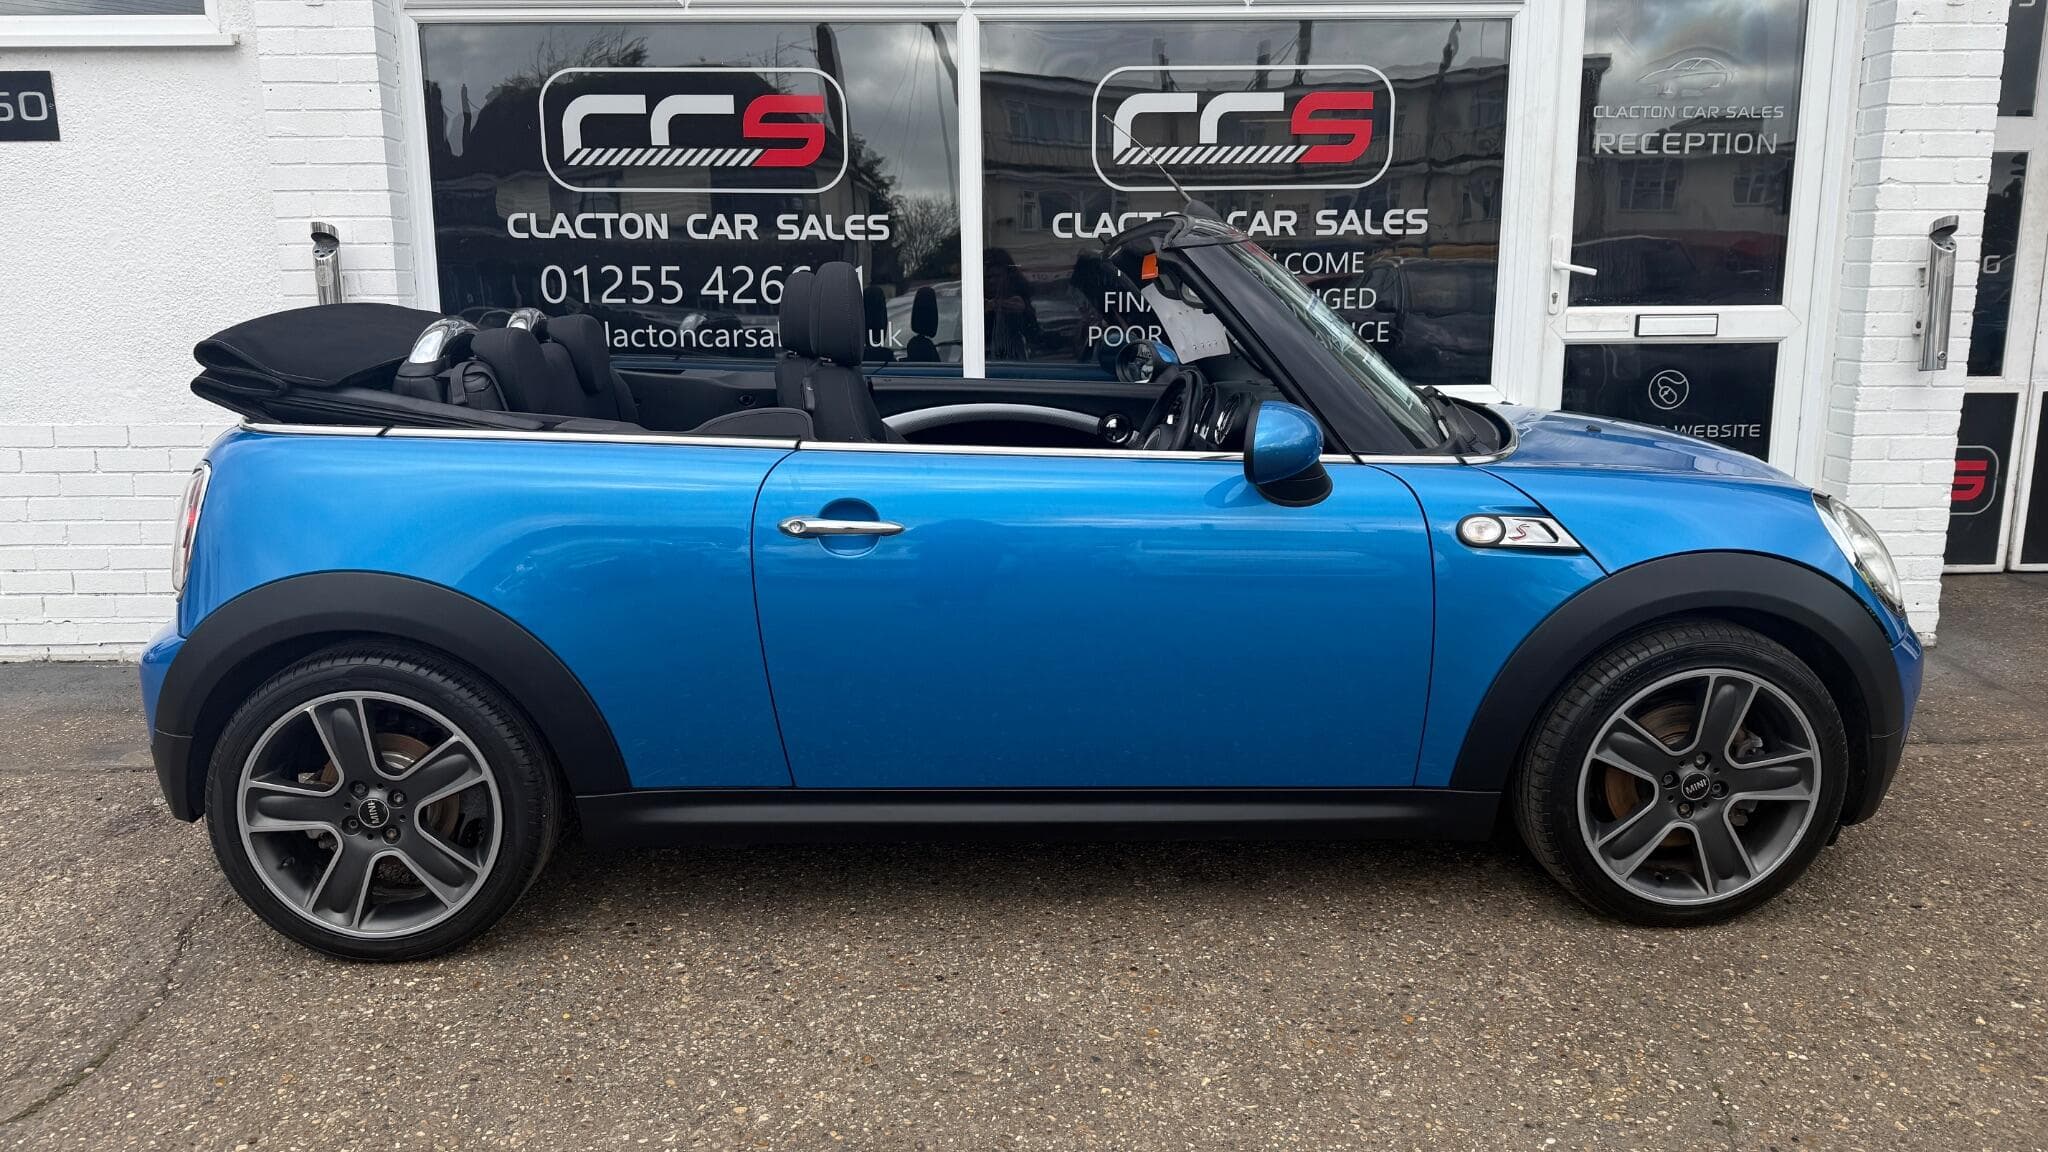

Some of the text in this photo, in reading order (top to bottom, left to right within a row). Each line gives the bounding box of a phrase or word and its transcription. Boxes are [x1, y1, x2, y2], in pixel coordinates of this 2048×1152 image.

[1593, 105, 1785, 119] CLACTON CAR SALES
[1594, 132, 1777, 155] RECEPTION
[506, 212, 891, 241] CLACTON CAR SALES
[1315, 208, 1430, 236] SALES
[540, 264, 684, 305] 01255
[1088, 325, 1162, 347] POOR
[1685, 779, 1707, 794] MINI
[367, 801, 380, 824] MINI
